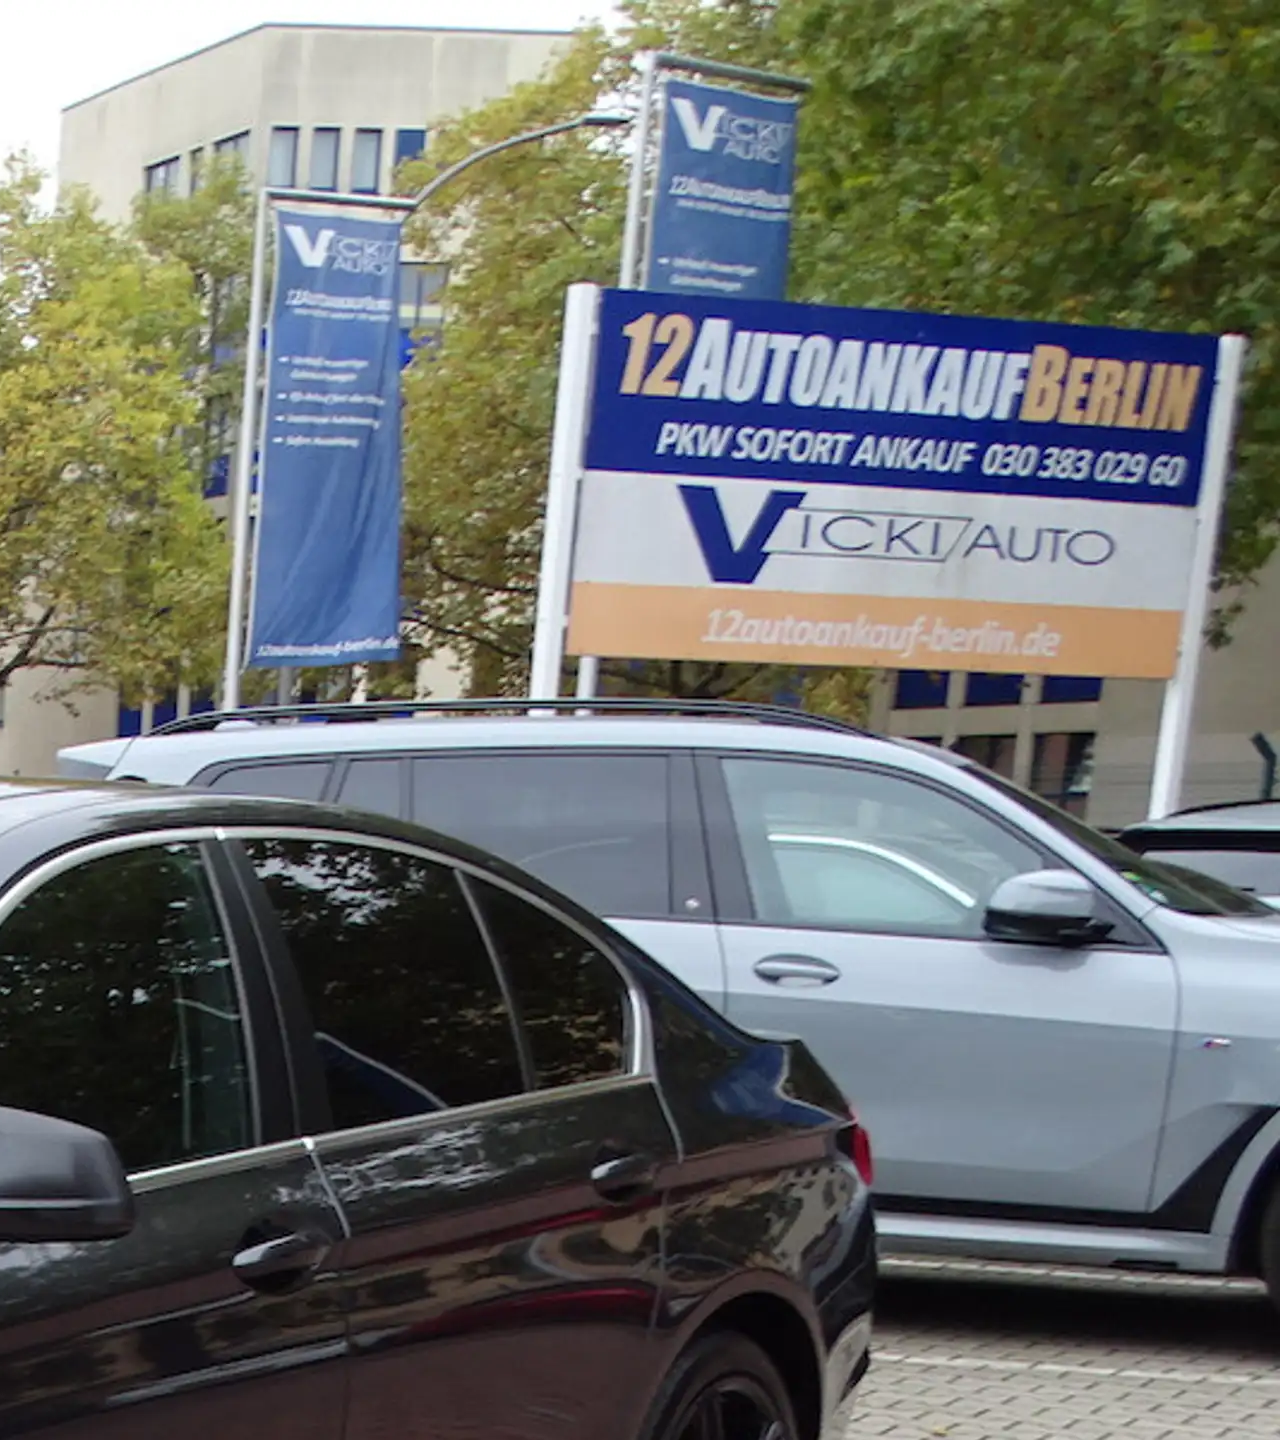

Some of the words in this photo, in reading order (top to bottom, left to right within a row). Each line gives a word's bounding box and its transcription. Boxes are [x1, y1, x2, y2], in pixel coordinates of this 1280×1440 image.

[655, 421, 734, 457] PKW
[731, 426, 856, 465] SOFORT
[850, 434, 978, 473] ANKAUF
[981, 443, 1041, 477] 030
[1036, 446, 1094, 481] 383
[1092, 450, 1150, 484] 029
[1147, 455, 1189, 488] 60
[677, 484, 948, 585] VICKI
[962, 524, 1117, 567] AUTO
[701, 608, 1063, 659] 12autoankauf-berlin.de
